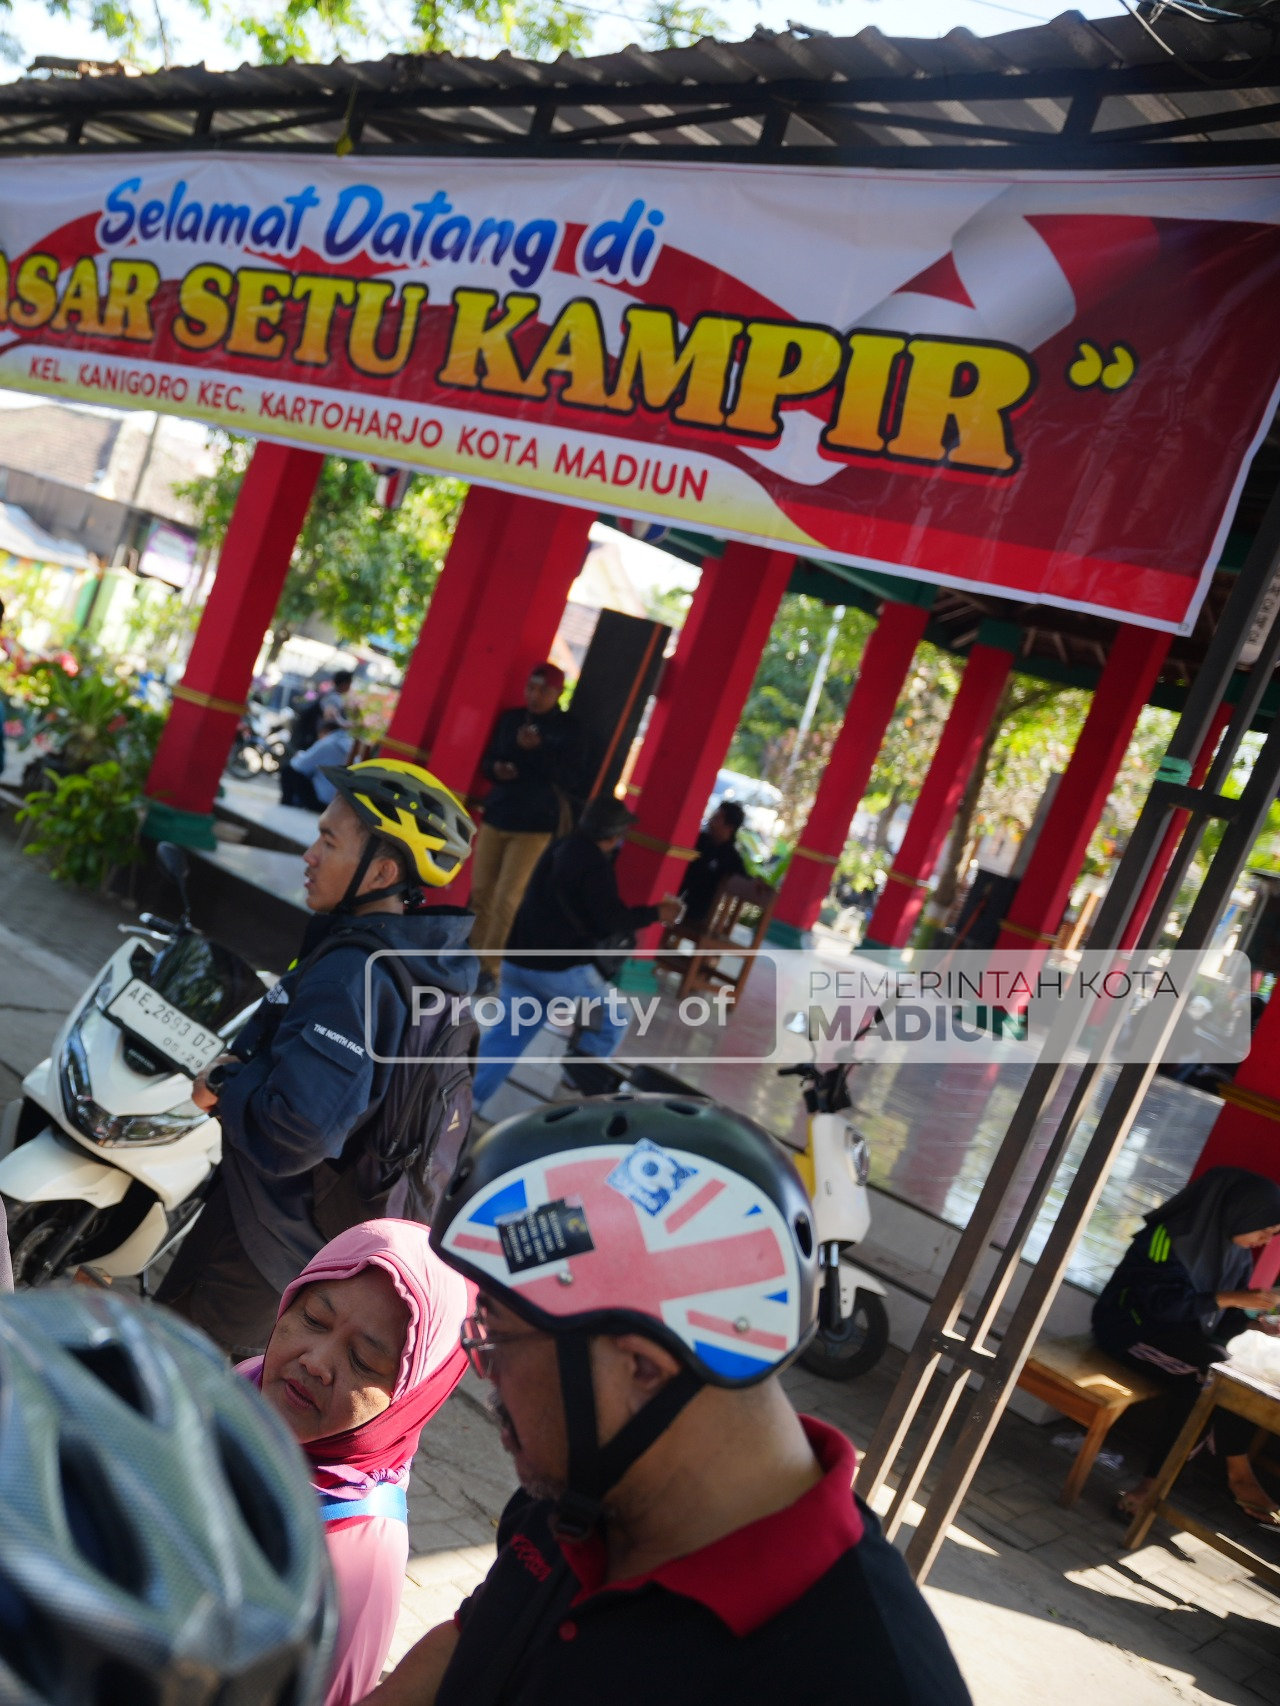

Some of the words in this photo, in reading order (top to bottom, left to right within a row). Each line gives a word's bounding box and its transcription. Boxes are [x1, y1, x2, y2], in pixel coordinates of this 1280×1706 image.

[100, 177, 321, 251] Selamat
[324, 184, 558, 288] Datang
[582, 199, 665, 278] di
[173, 262, 429, 378] SETU
[436, 287, 1039, 478] KAMPIR
[28, 357, 68, 385] KEL.
[79, 363, 189, 402] KANIGORO
[197, 380, 245, 413] KEC.
[259, 391, 443, 449] KARTOHARJO
[457, 425, 540, 469] KOTA
[553, 443, 710, 502] MADIUN
[127, 986, 152, 1008] AE
[313, 1023, 328, 1036] THE
[325, 1029, 349, 1047] NORTH
